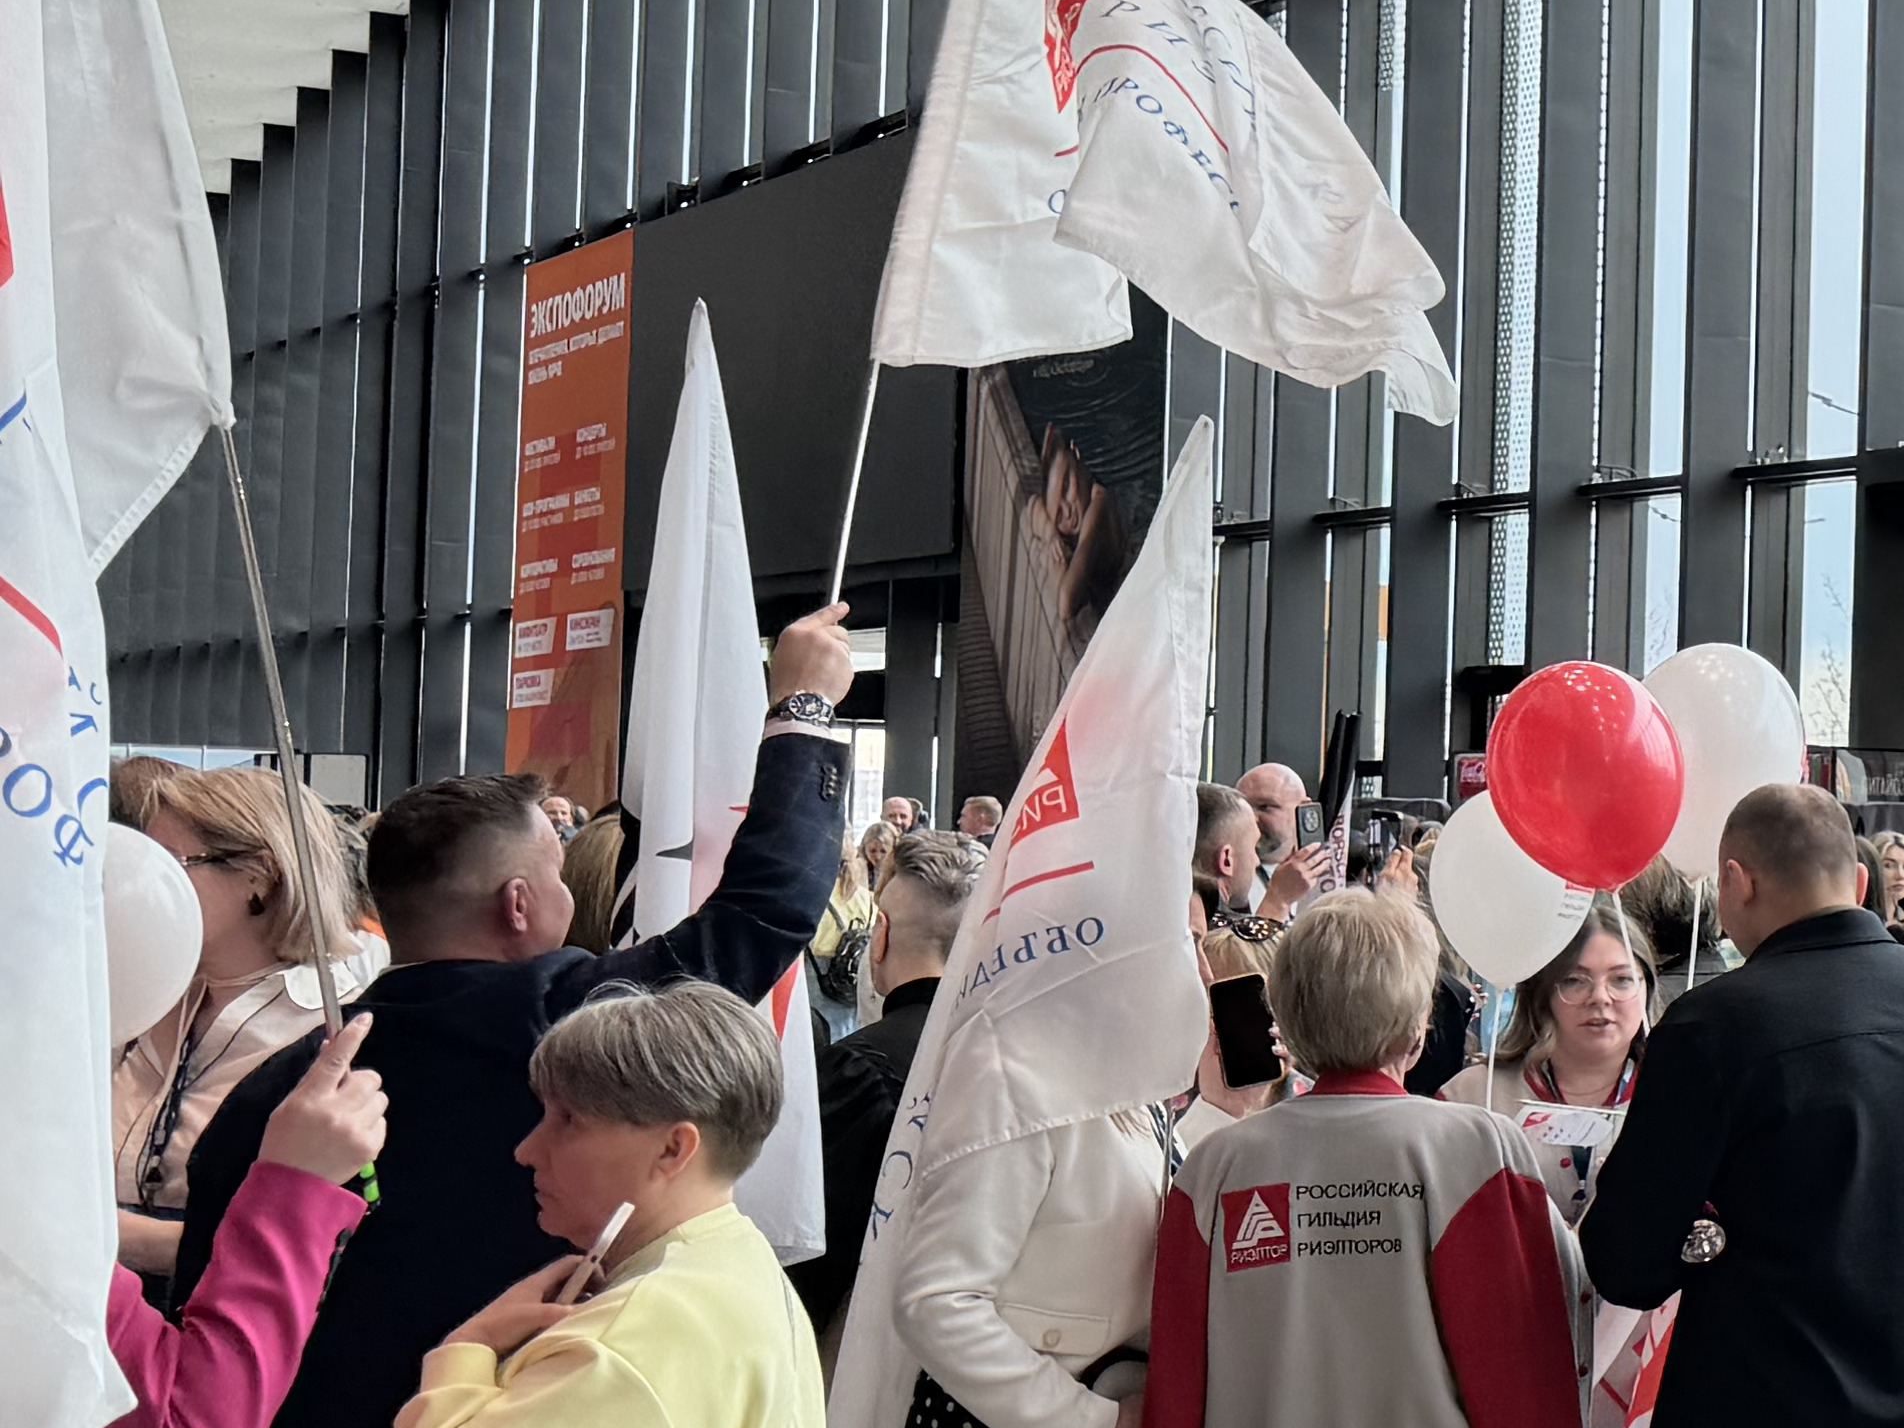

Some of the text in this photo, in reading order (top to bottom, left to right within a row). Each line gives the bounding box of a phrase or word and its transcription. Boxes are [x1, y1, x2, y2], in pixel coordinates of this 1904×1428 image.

[529, 271, 626, 339] ЭКСПОФОРУМ
[1296, 1180, 1425, 1200] РОССИЙСКАЯ
[1297, 1210, 1381, 1229] ГИЛЬДИЯ
[1230, 1243, 1288, 1264] РИЭЛТОР
[1297, 1238, 1402, 1257] РИЭЛТОРОВ
